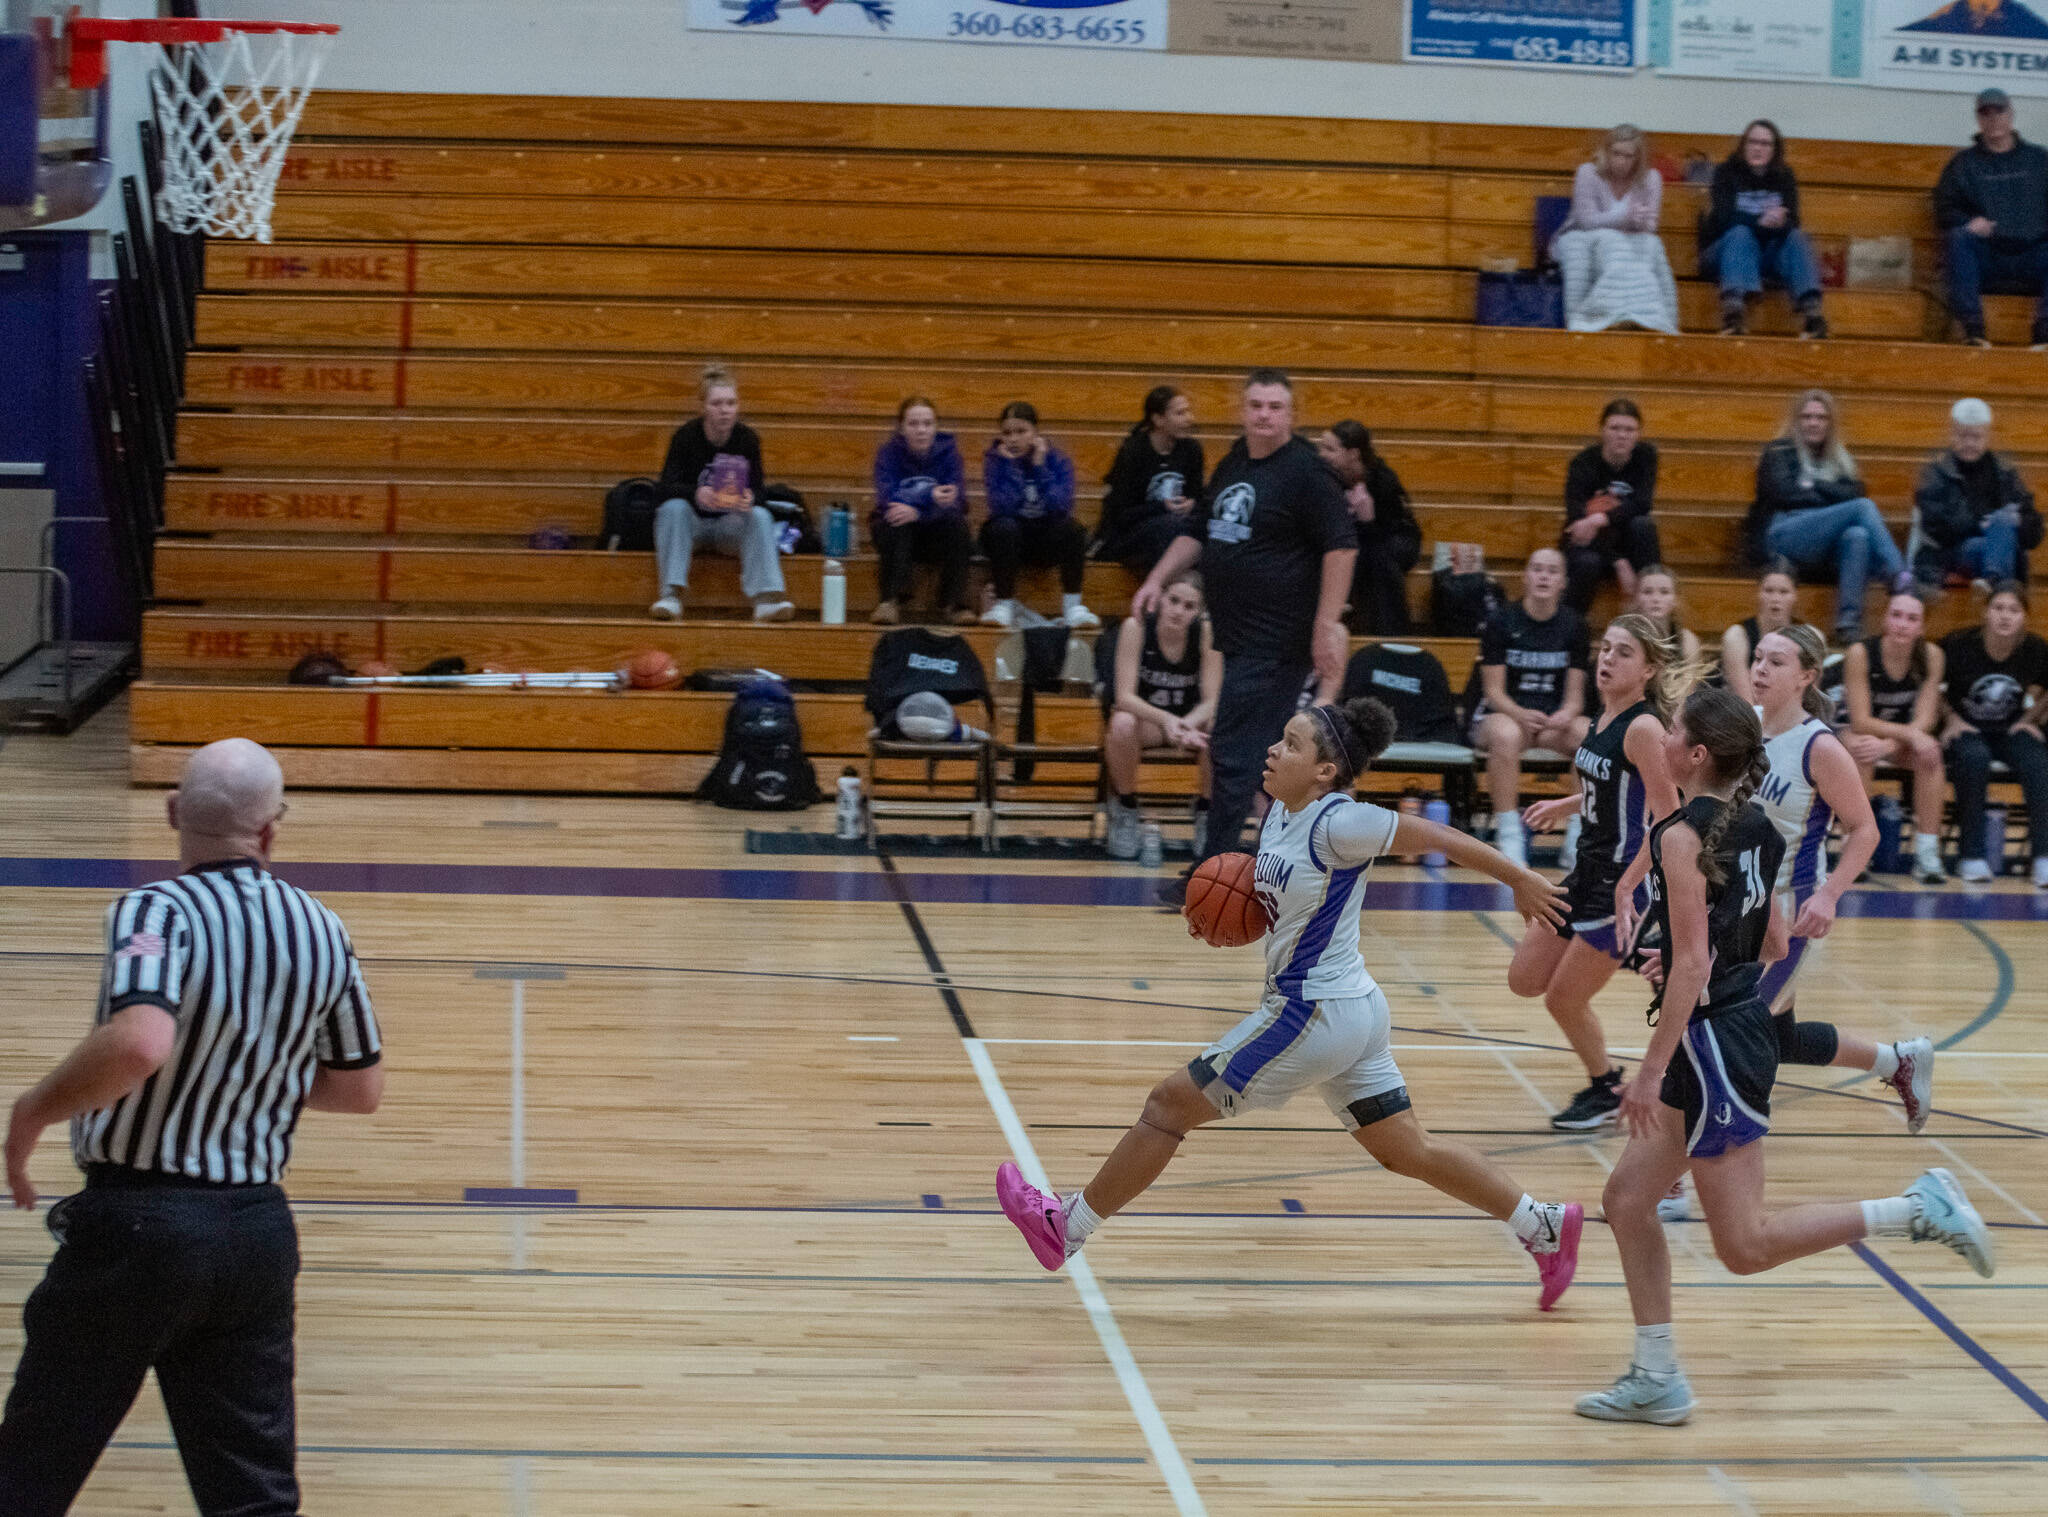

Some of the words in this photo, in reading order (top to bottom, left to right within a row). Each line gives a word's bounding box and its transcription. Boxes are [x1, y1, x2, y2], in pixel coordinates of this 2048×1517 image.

[947, 11, 1146, 45] 360-683-6655
[1513, 36, 1630, 65] 683-4848
[1893, 45, 1940, 65] A-M
[325, 158, 395, 181] AISLE
[246, 256, 303, 280] FIRE
[319, 256, 390, 281] AISLE
[228, 365, 286, 390] FIRE
[302, 367, 375, 392] AISLE
[208, 493, 268, 518] FIRE
[286, 494, 364, 520] AISLE
[186, 630, 249, 656] FIRE
